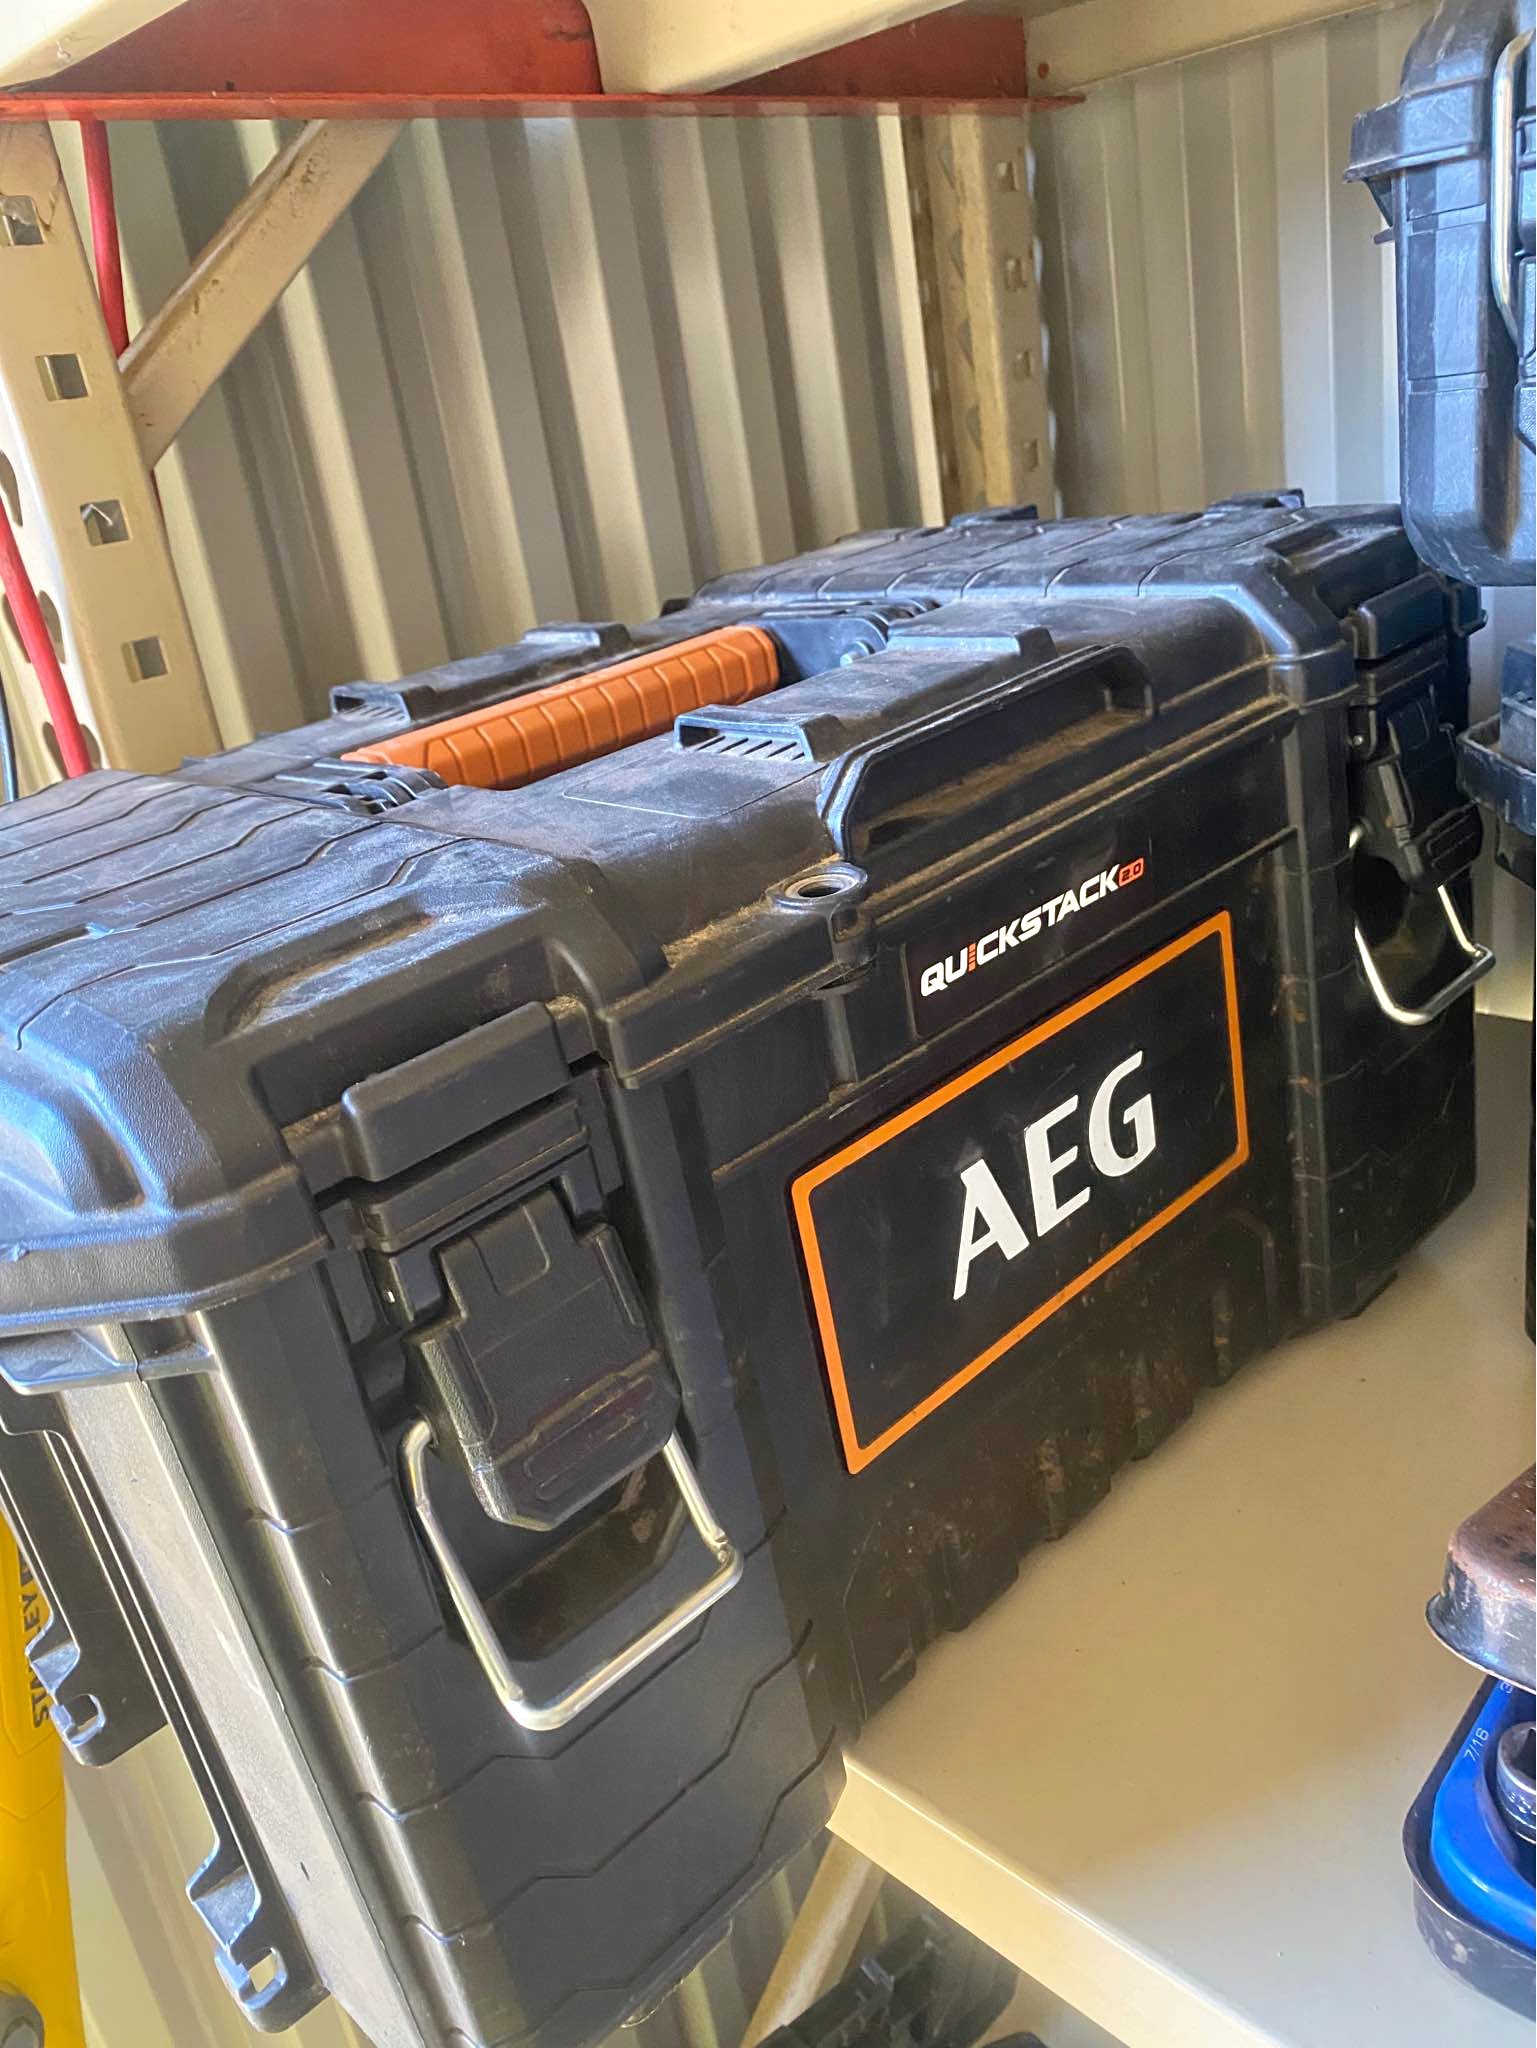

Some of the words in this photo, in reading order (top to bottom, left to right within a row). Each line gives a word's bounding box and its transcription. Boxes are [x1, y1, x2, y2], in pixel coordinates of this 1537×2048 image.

[920, 864, 1120, 997] QUICKSTACK
[1119, 859, 1144, 886] 2.0
[953, 1050, 1157, 1300] AEG
[1464, 1728, 1489, 1762] 7/16
